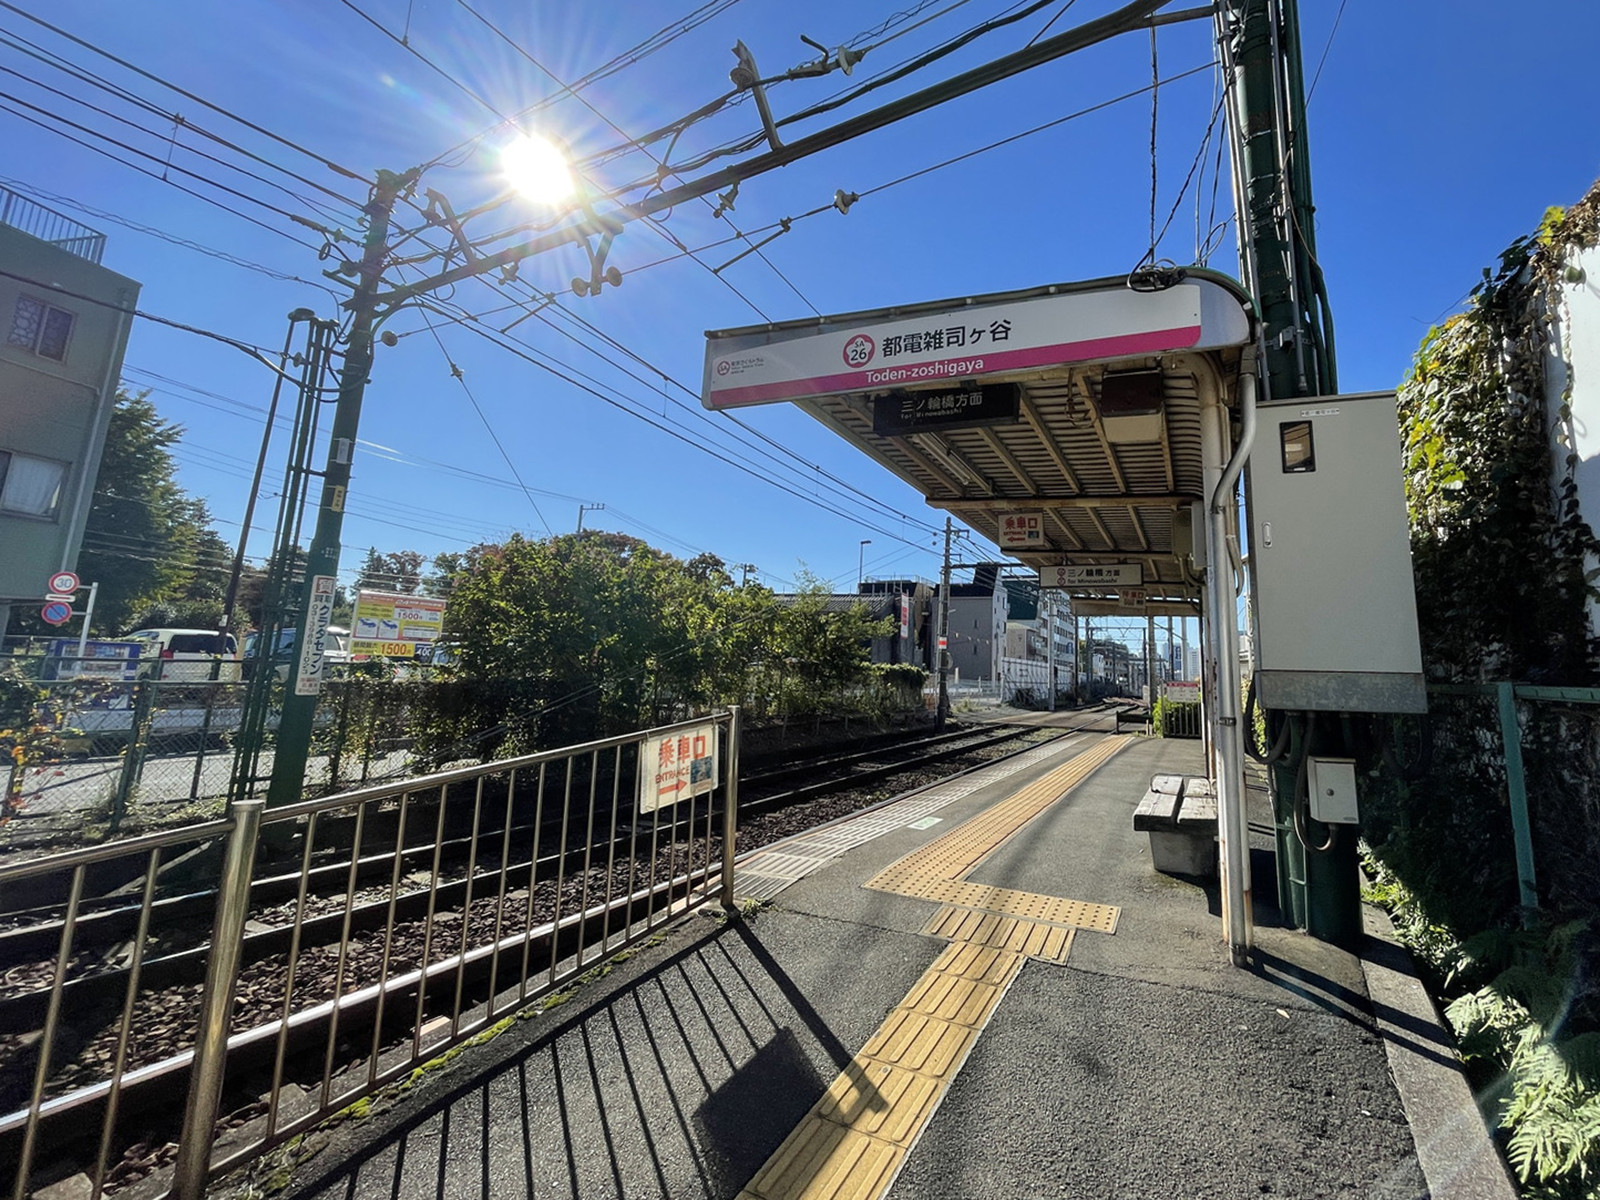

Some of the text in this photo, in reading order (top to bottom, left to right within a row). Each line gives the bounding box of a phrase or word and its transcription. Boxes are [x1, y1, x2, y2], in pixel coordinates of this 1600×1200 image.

[854, 340, 864, 348] SA
[881, 319, 1012, 358] 都電雑司ヶ谷
[850, 349, 867, 361] 26
[866, 358, 984, 383] Toden-zoshigaya
[901, 391, 983, 412] 三ノ輪橋方面
[1005, 516, 1038, 530] 乗車口
[56, 578, 73, 588] 30
[658, 735, 706, 769] 乗車口
[654, 765, 690, 785] ENTRANCE
